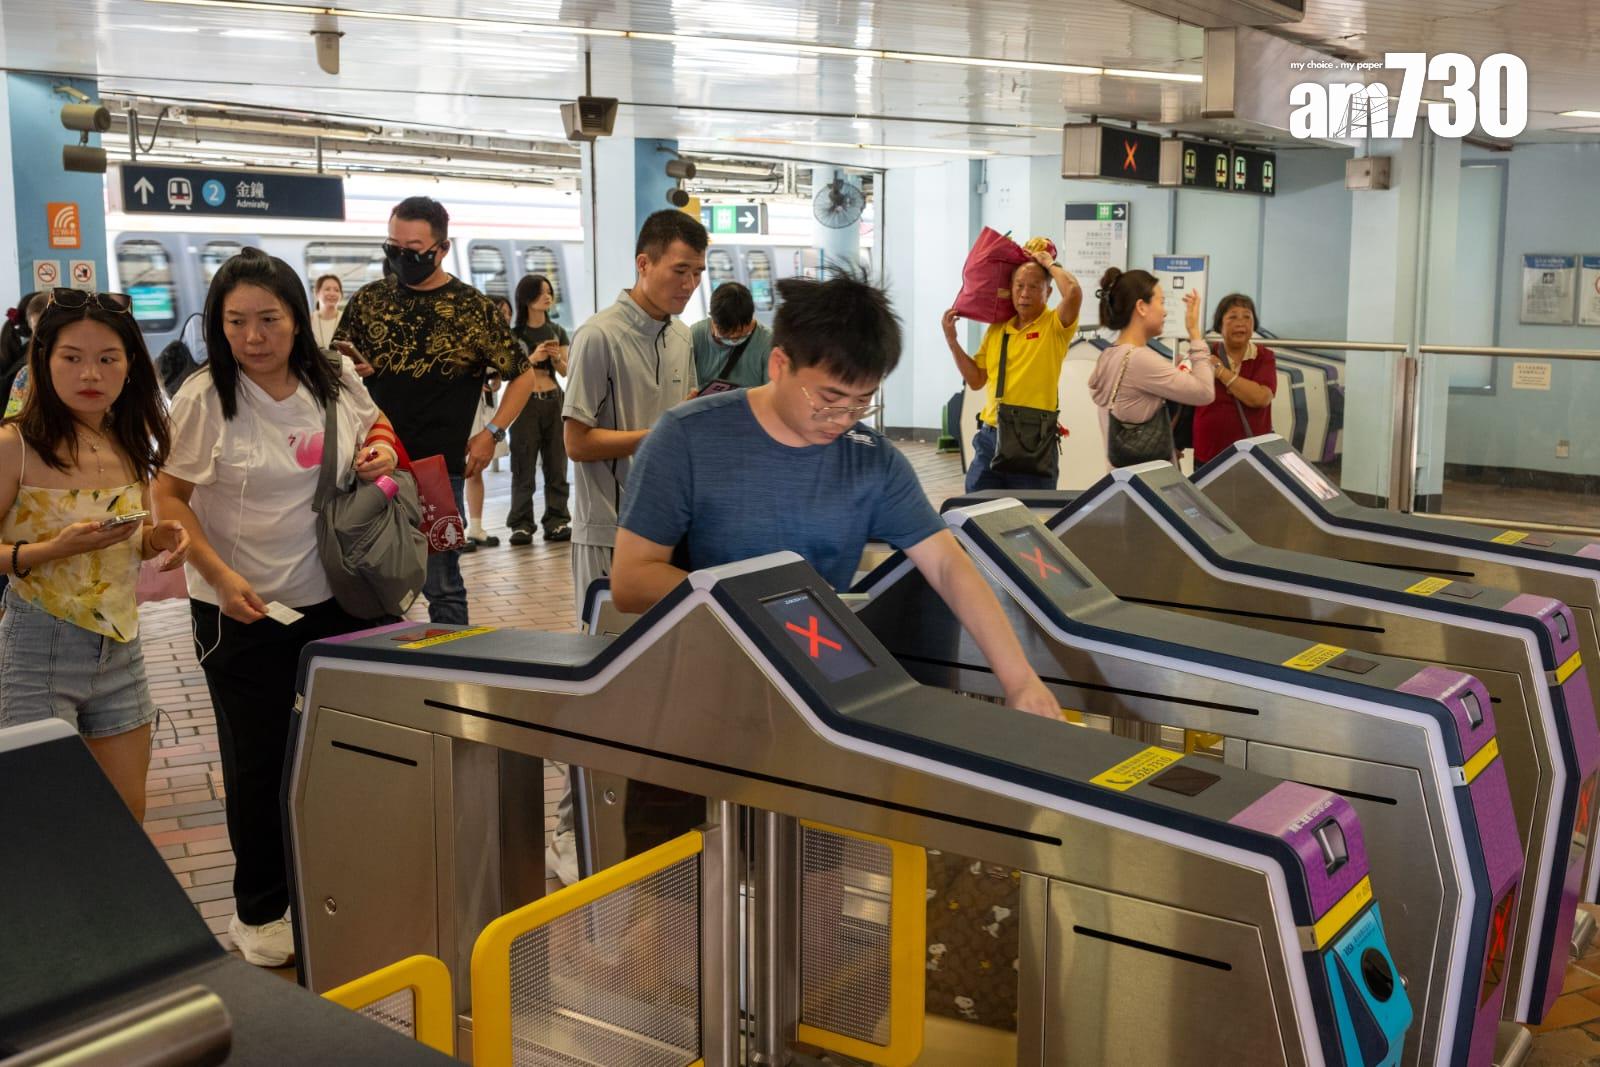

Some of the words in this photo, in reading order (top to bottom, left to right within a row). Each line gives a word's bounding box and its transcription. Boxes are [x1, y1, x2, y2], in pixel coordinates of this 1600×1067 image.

[208, 184, 220, 201] 2
[236, 181, 265, 199] 金鐘
[236, 199, 270, 211] Admiralty
